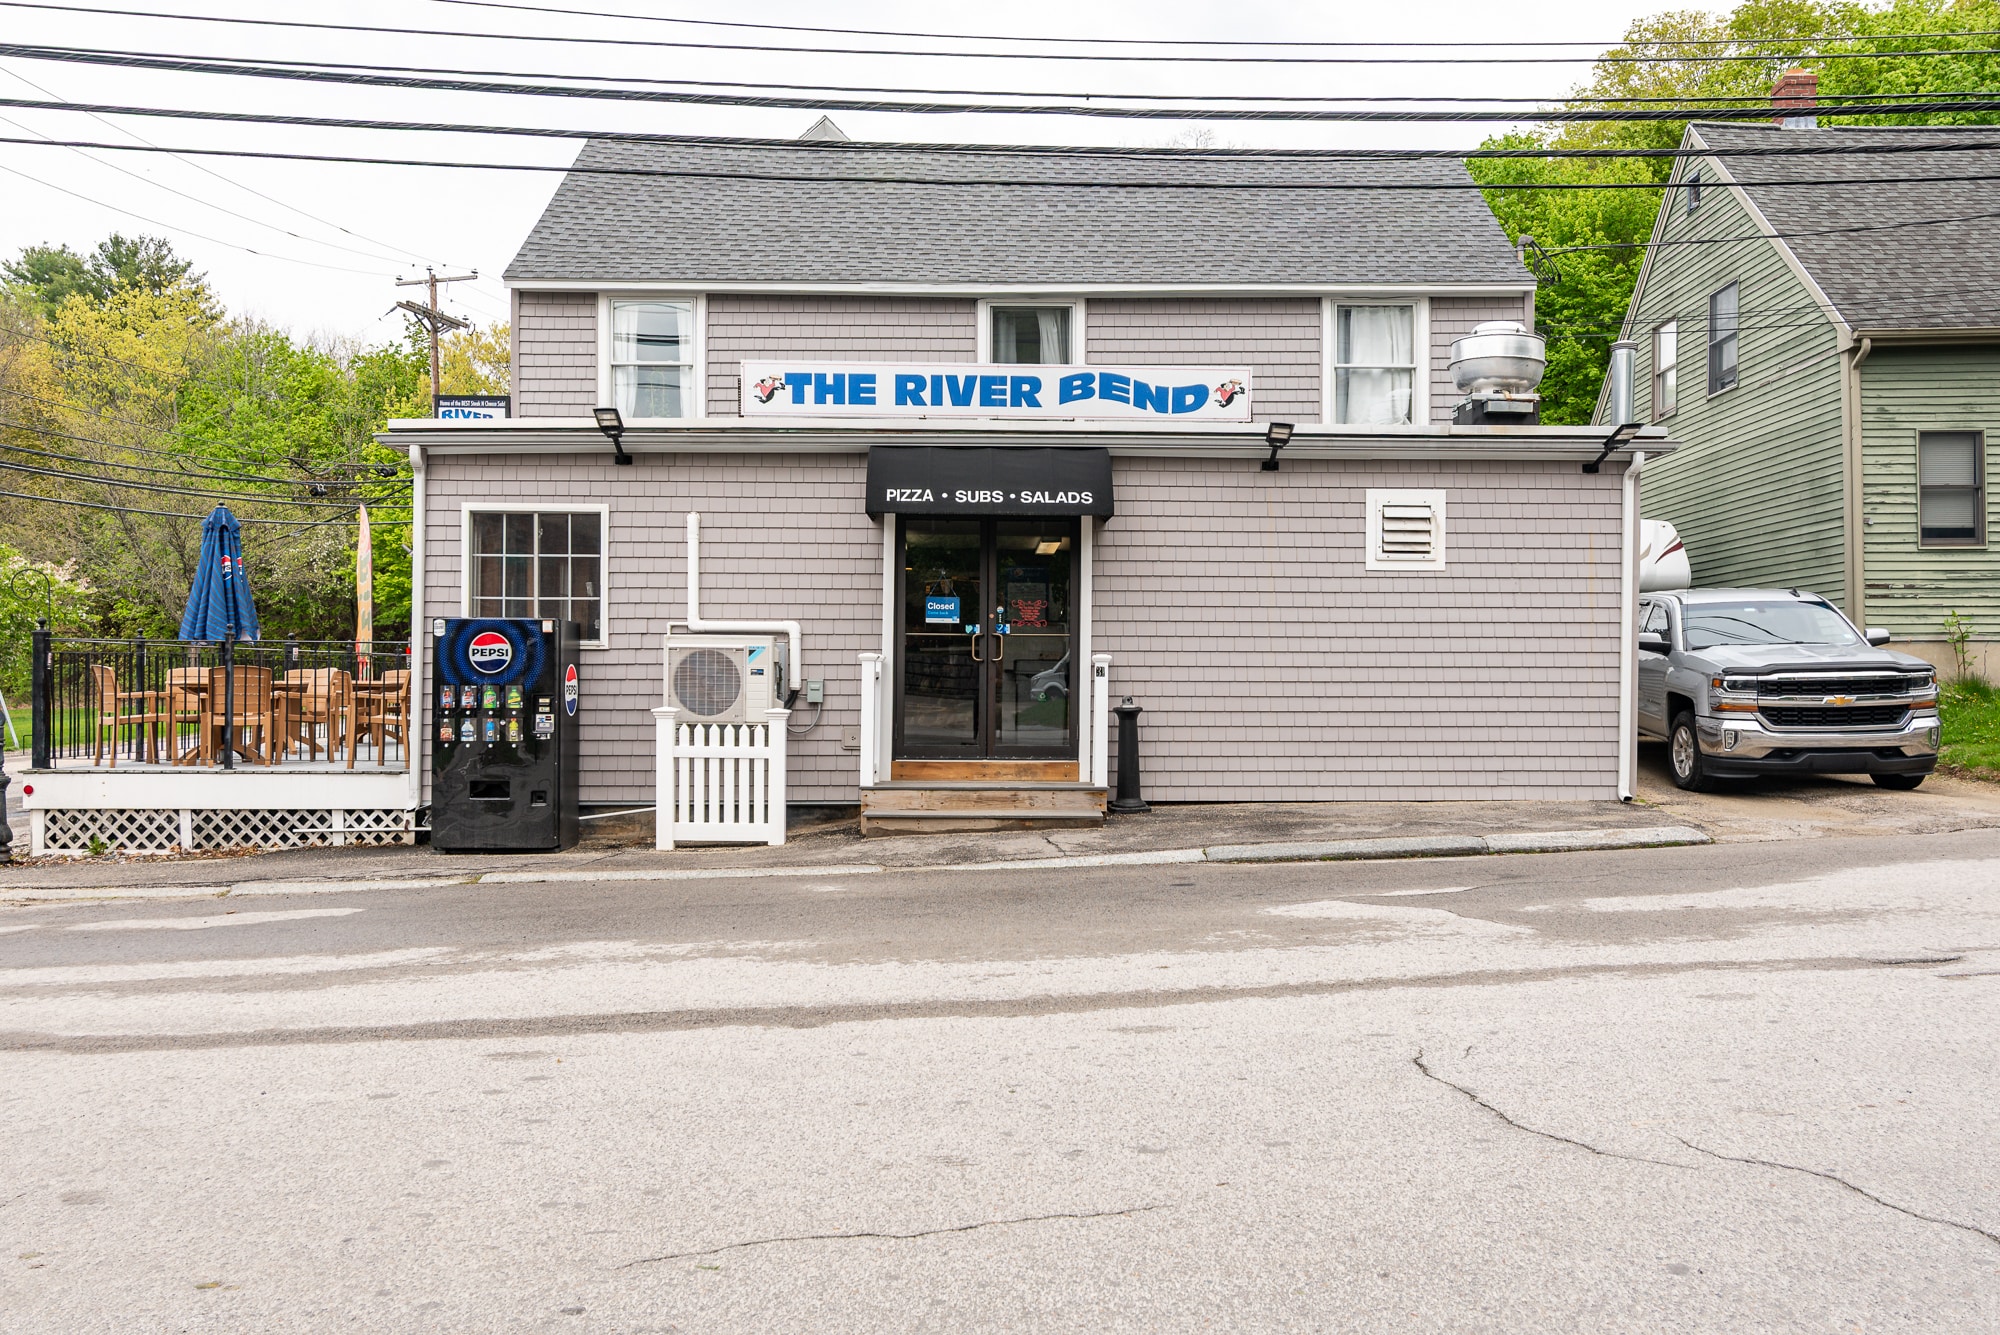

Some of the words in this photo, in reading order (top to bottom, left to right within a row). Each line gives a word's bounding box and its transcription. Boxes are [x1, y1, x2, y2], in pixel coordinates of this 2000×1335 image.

[785, 372, 876, 405] THE
[894, 374, 1043, 408] RIVER
[1059, 371, 1210, 414] BEND
[886, 488, 933, 502] PIZZA
[955, 490, 1004, 503] SUBS
[1020, 491, 1093, 504] SALADS
[927, 602, 955, 610] Closed
[472, 648, 509, 657] PEPSI
[566, 684, 577, 695] PEPSI
